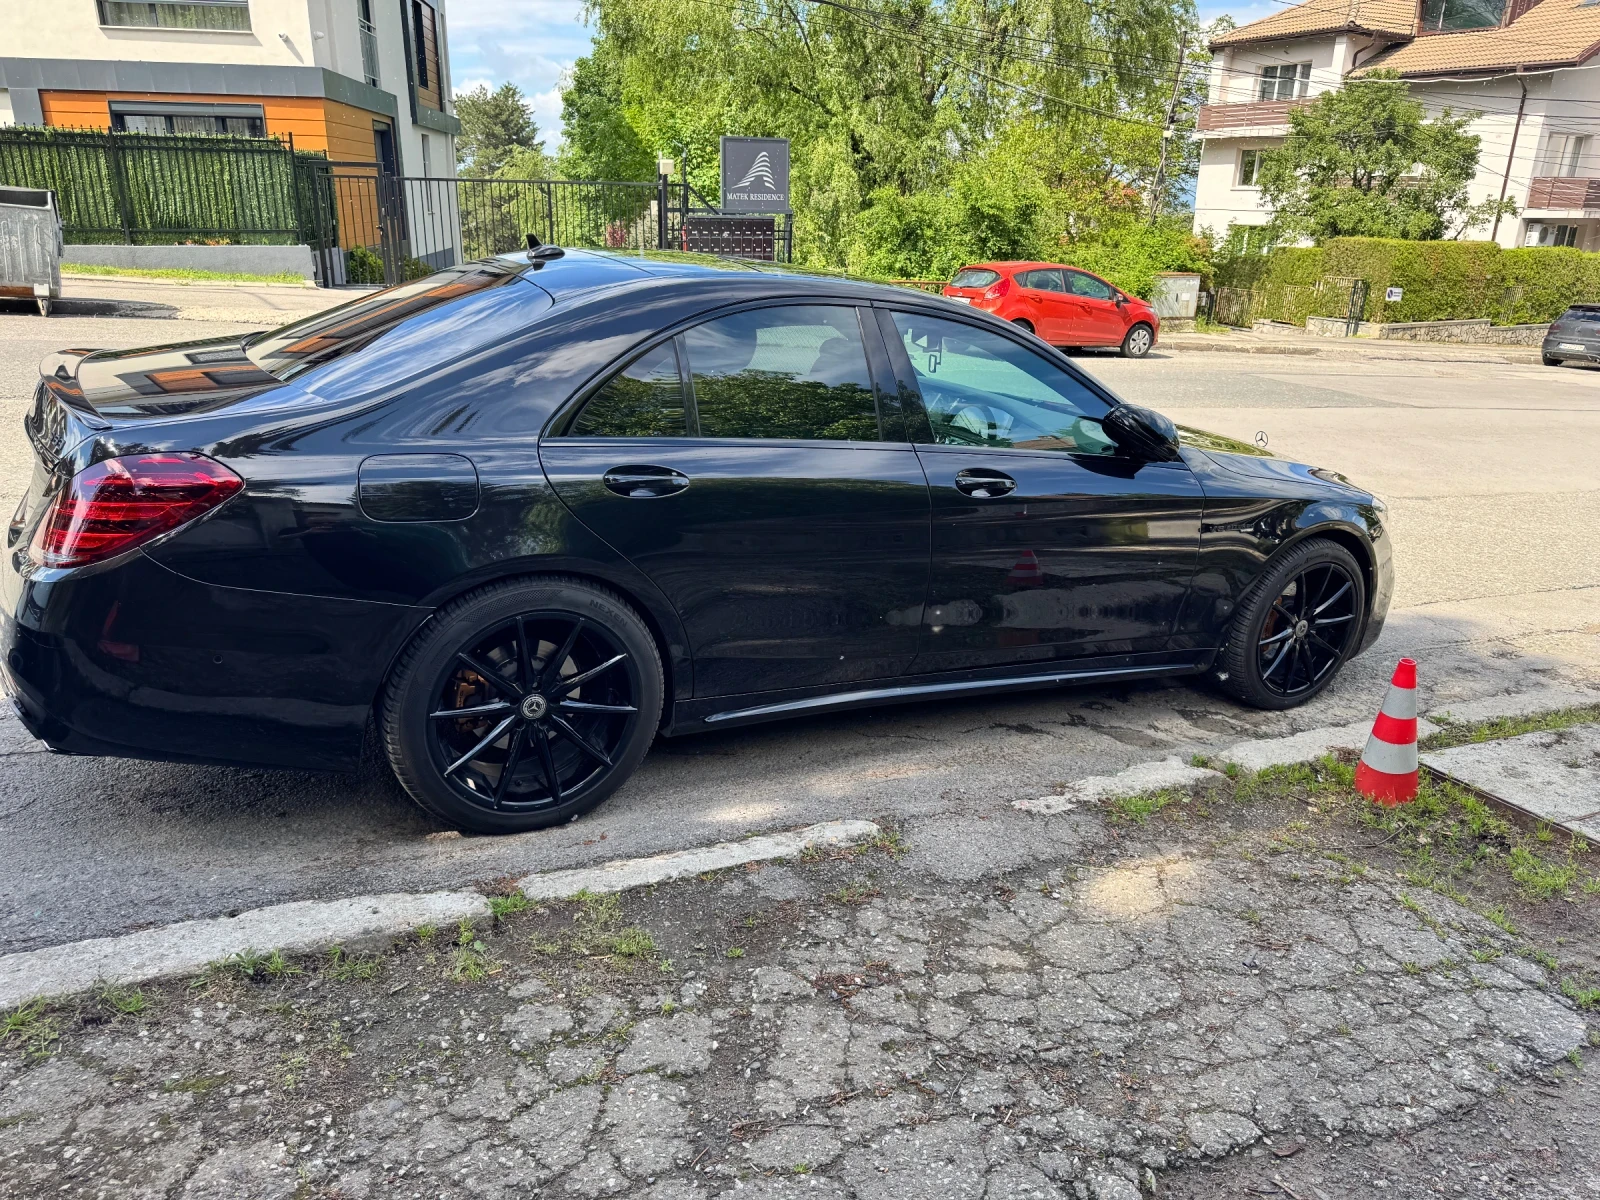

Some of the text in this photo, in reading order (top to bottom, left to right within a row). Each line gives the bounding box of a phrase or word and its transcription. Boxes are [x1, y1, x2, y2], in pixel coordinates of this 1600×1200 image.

[726, 192, 785, 201] MATEK RESIDENCE
[589, 599, 628, 627] NEXEN
